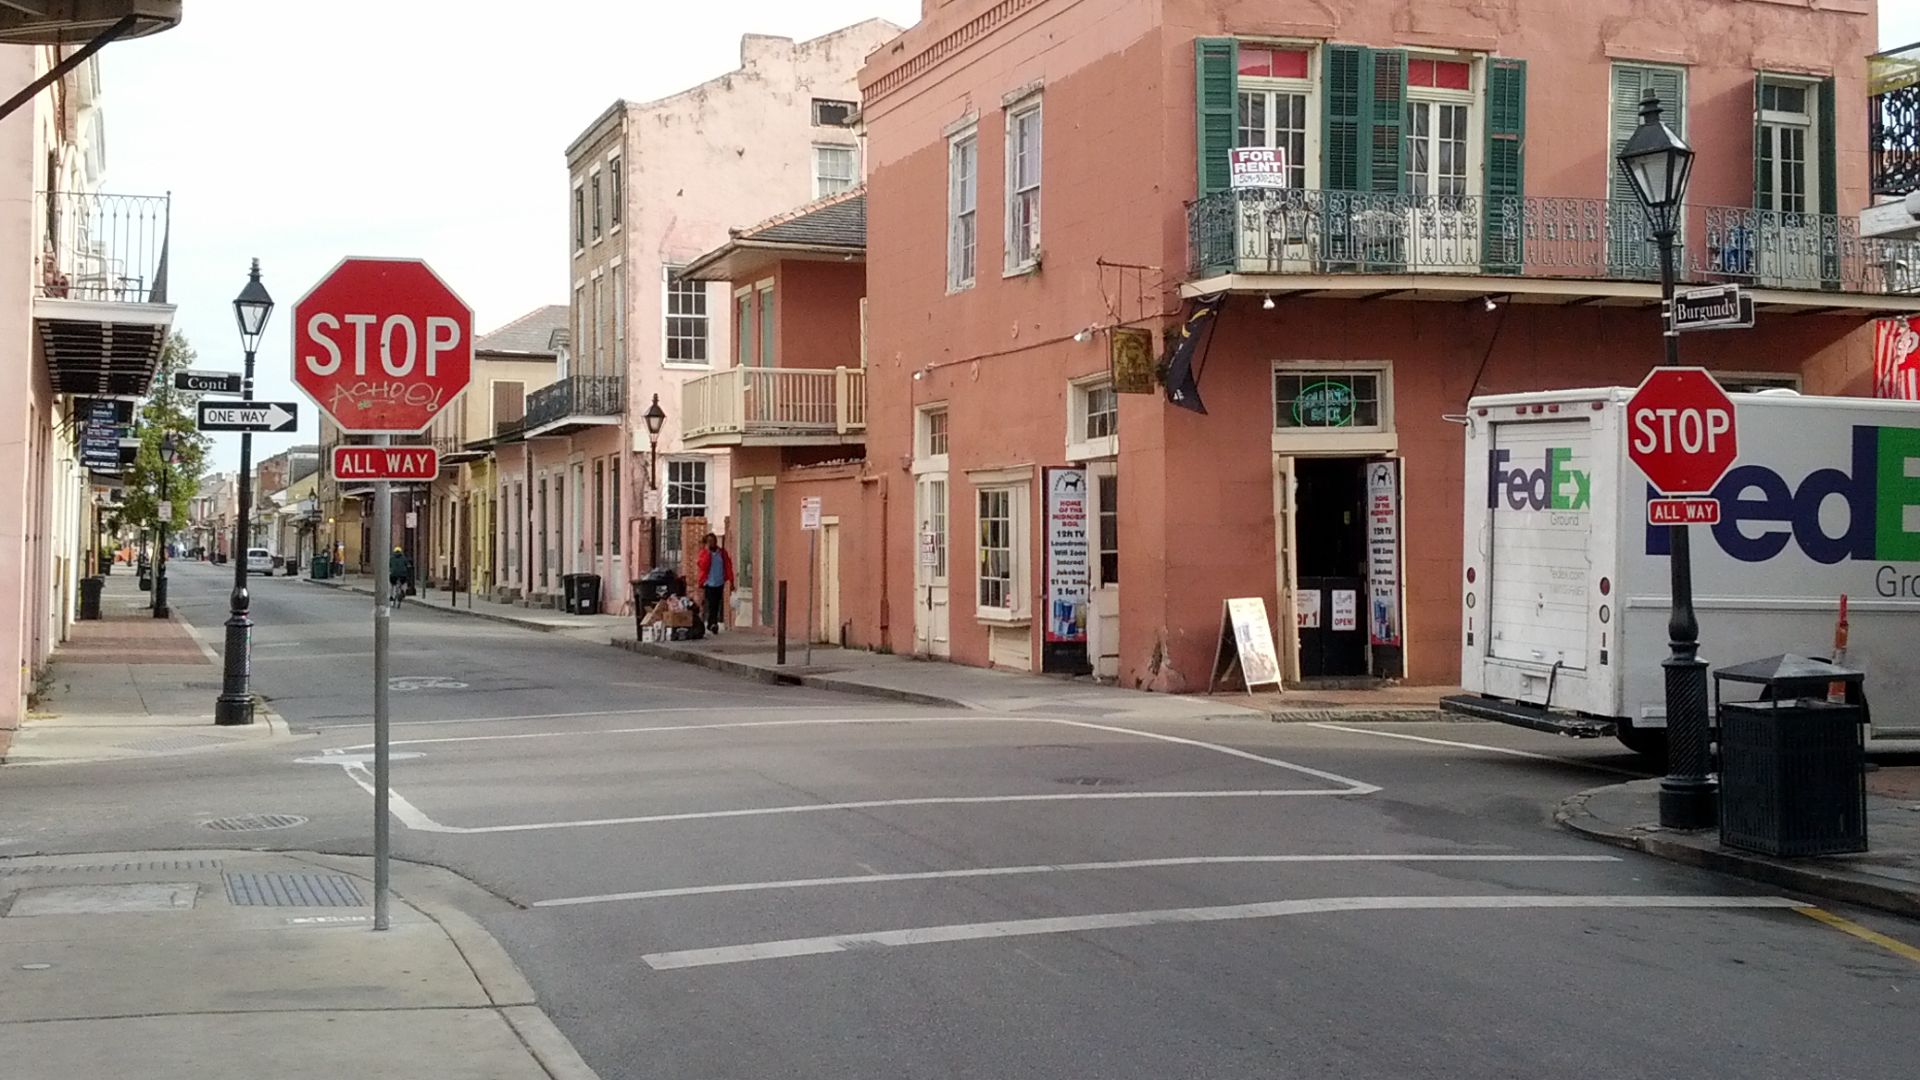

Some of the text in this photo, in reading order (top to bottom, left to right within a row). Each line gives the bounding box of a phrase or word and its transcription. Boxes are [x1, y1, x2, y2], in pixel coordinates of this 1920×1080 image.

[1238, 151, 1275, 162] FOR
[1234, 161, 1281, 173] RENT
[1677, 298, 1737, 322] Burgundy
[305, 312, 461, 377] STOP
[187, 375, 228, 391] Conti
[208, 410, 268, 423] ONE WAY
[1634, 408, 1730, 454] STOP
[341, 454, 428, 473] ALL WAY
[1488, 447, 1591, 511] FedEx
[1645, 425, 1920, 565] edE
[1551, 513, 1579, 526] Ground
[1654, 505, 1714, 520] ALL WAY
[1312, 611, 1318, 626] 1
